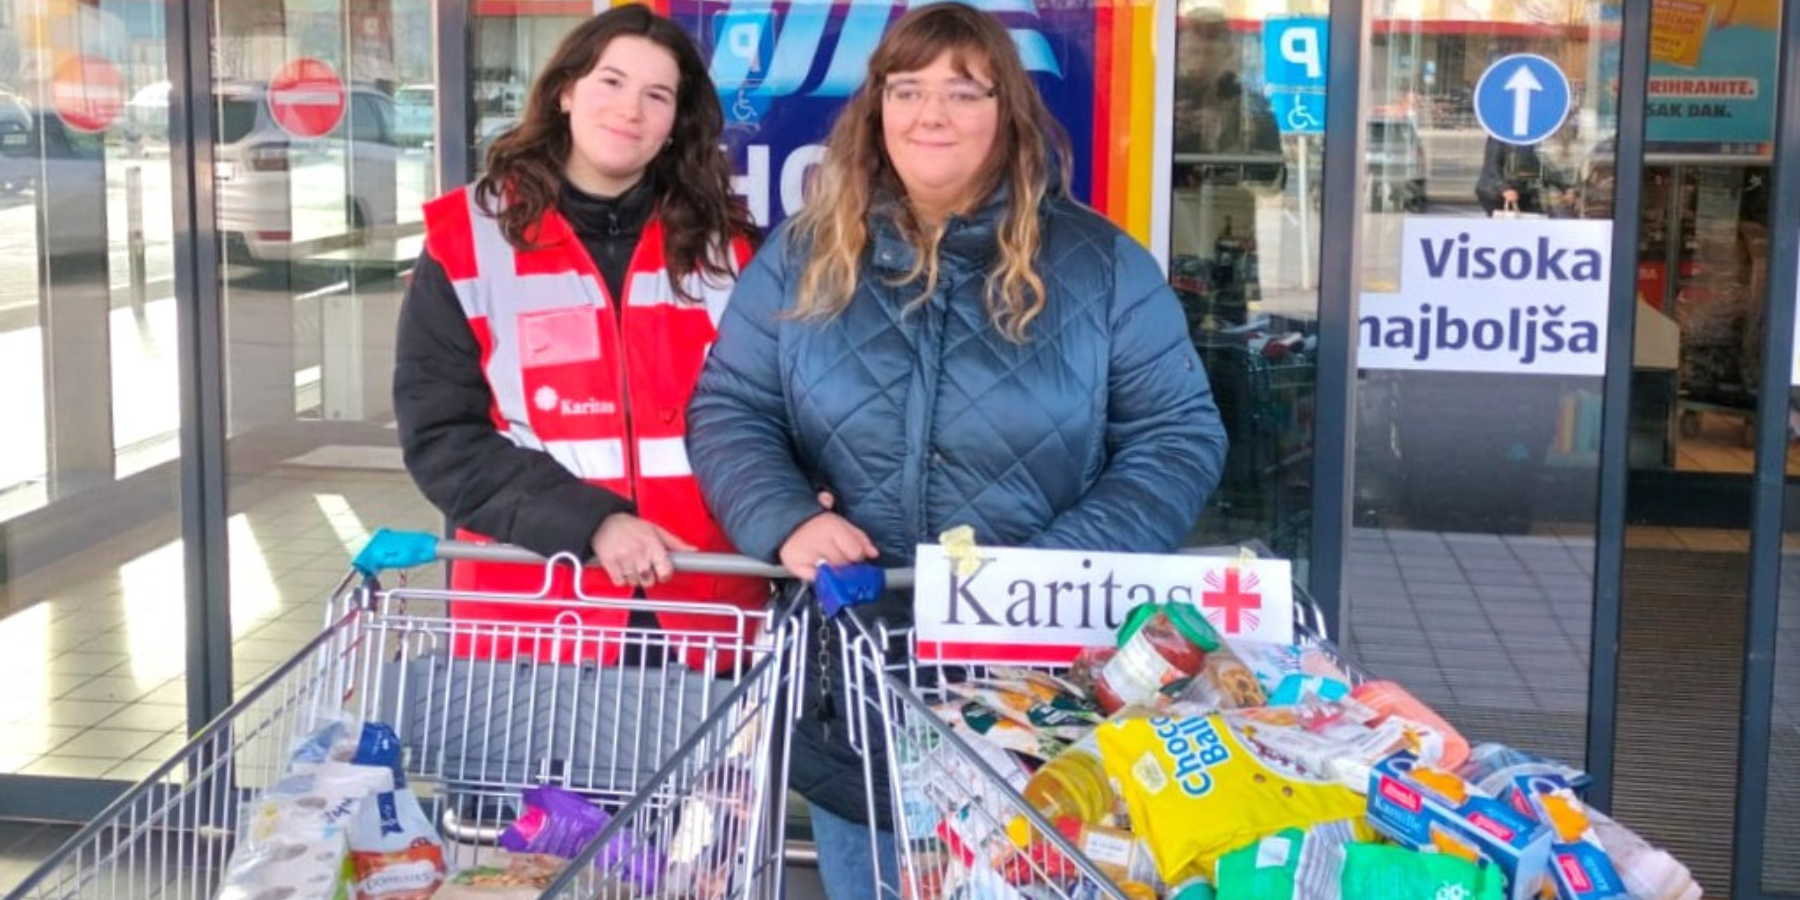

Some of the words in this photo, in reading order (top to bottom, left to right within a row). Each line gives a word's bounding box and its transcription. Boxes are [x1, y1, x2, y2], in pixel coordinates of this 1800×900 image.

[1649, 79, 1755, 96] RIHRANITE.
[1646, 103, 1683, 118] SAK
[1419, 232, 1602, 282] Visoka
[1358, 303, 1599, 364] najboljša
[561, 397, 615, 416] Karitas
